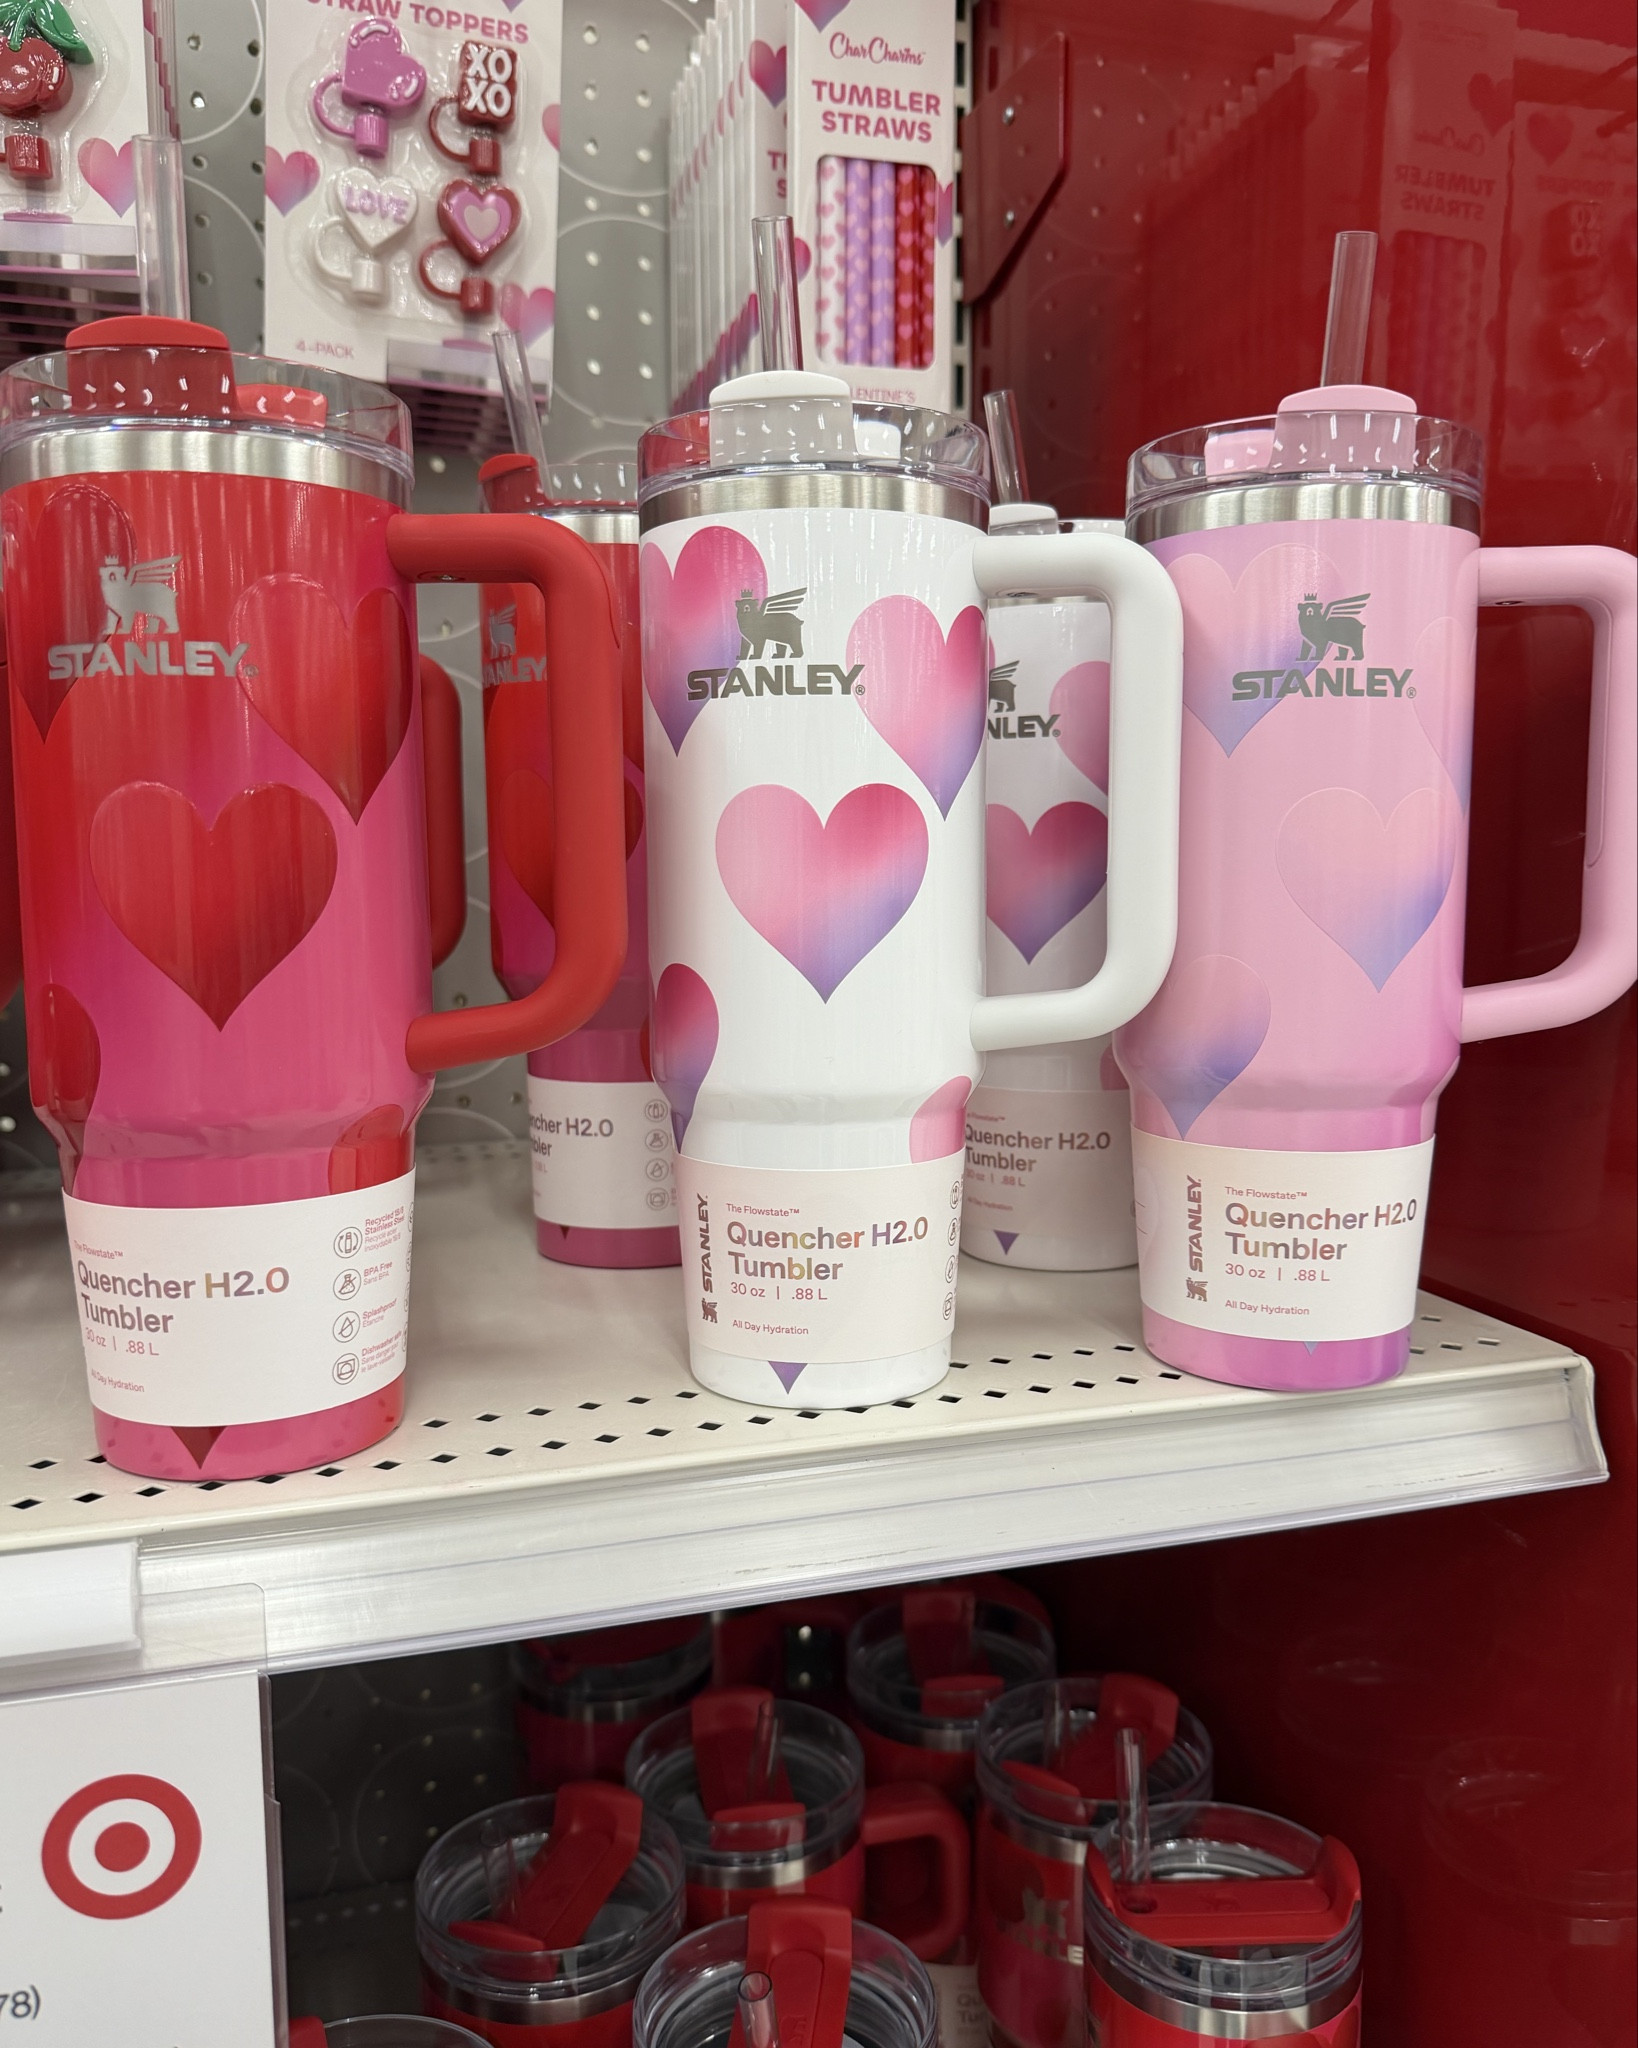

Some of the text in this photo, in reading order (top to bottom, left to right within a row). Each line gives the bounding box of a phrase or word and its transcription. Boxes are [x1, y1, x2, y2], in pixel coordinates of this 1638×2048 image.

[307, 0, 529, 43] RAW TOPPERS
[468, 47, 512, 80] XO
[468, 80, 512, 117] XO
[812, 79, 940, 117] TUMBLER
[822, 110, 932, 144] STRAWS
[340, 185, 409, 225] LOVE
[296, 340, 355, 360] 4-PACK
[966, 1123, 1053, 1150] Quencher
[966, 1145, 1037, 1172] Tumbler
[1225, 1186, 1244, 1197] The
[726, 1203, 742, 1214] The
[1225, 1202, 1369, 1231] Quencher
[727, 1221, 866, 1250] Quencher
[1224, 1231, 1348, 1261] Tumbler
[364, 1266, 378, 1277] BPA
[727, 1250, 844, 1281] Tumbler
[1225, 1263, 1244, 1276] 30
[1248, 1268, 1266, 1279] oz
[1294, 1270, 1316, 1282] .88
[1321, 1270, 1330, 1282] L
[78, 1260, 196, 1300] Quencher
[730, 1281, 747, 1296] 30
[750, 1286, 766, 1298] oz
[791, 1287, 814, 1301] .88
[818, 1288, 828, 1300] L
[81, 1292, 174, 1334] Tumbler
[1225, 1299, 1310, 1315] All Day Hydration
[732, 1319, 809, 1336] All Day Hydration
[96, 1336, 106, 1348] oz
[126, 1340, 145, 1355] .88
[148, 1342, 160, 1356] L
[108, 1376, 145, 1393] Hydration
